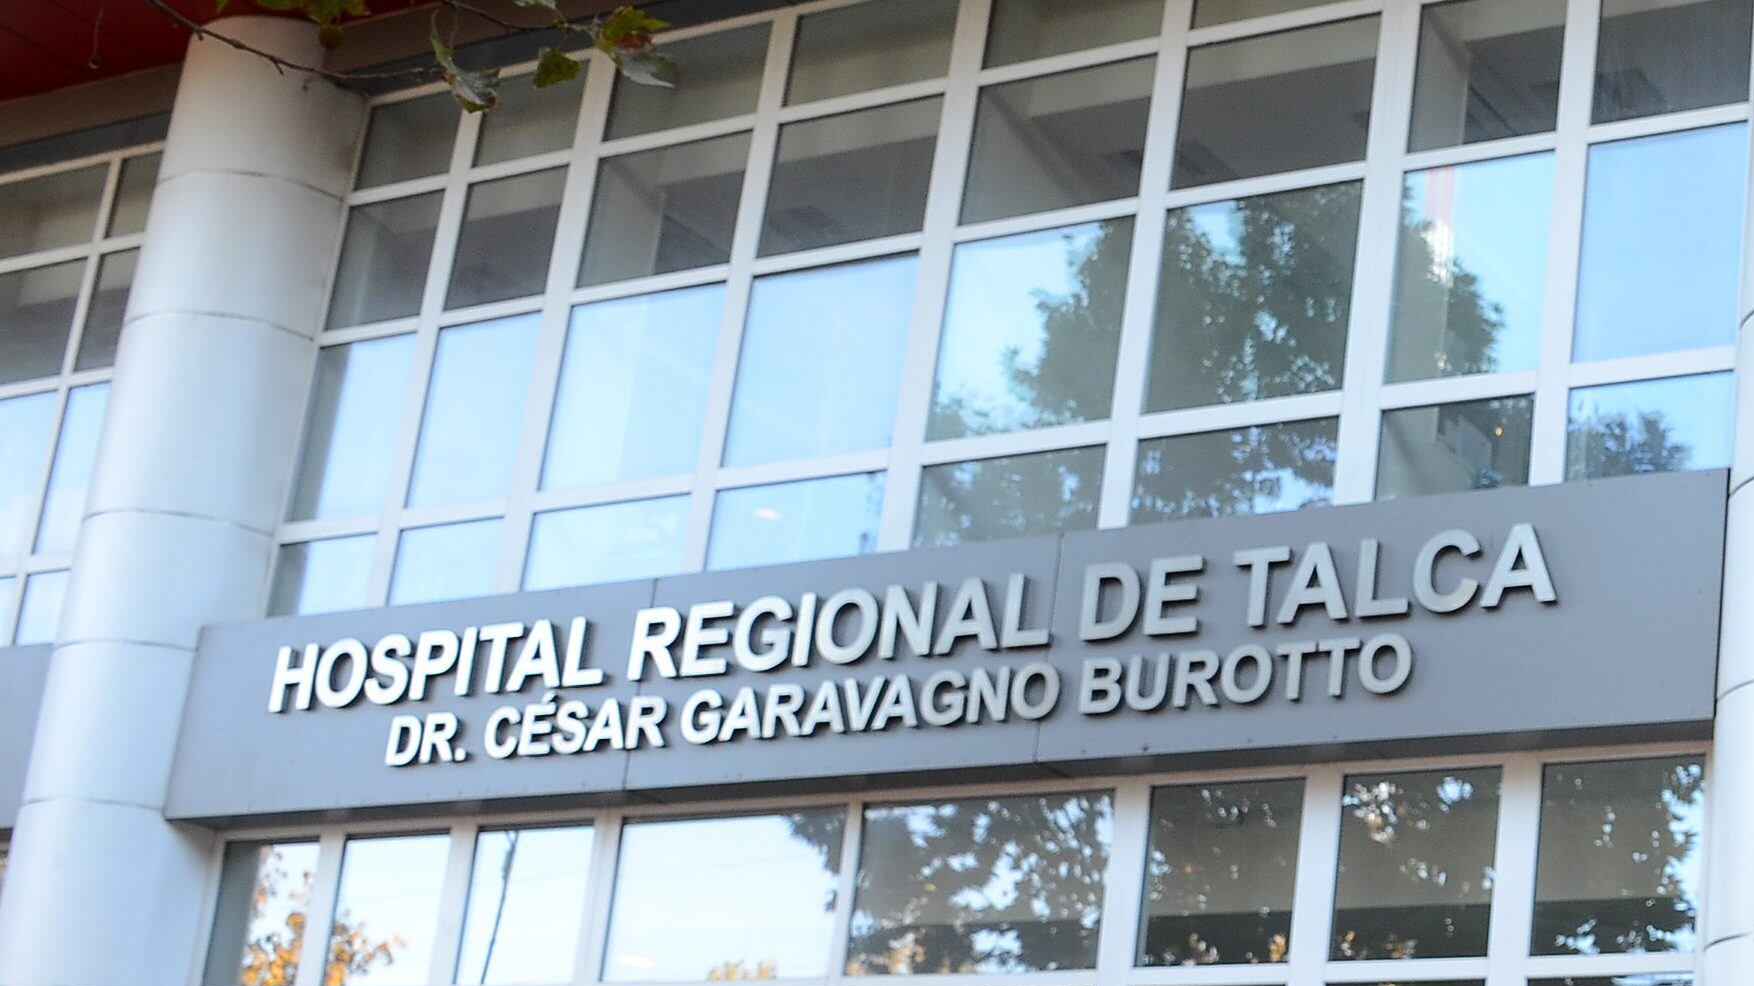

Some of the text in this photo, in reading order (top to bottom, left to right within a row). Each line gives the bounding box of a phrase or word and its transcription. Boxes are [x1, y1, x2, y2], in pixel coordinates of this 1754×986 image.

[268, 522, 1557, 713] HOSPITAL REGIONAL DE TALCA
[385, 633, 1414, 768] DR. CÉSAR GARAVAGNO BUROTTO
